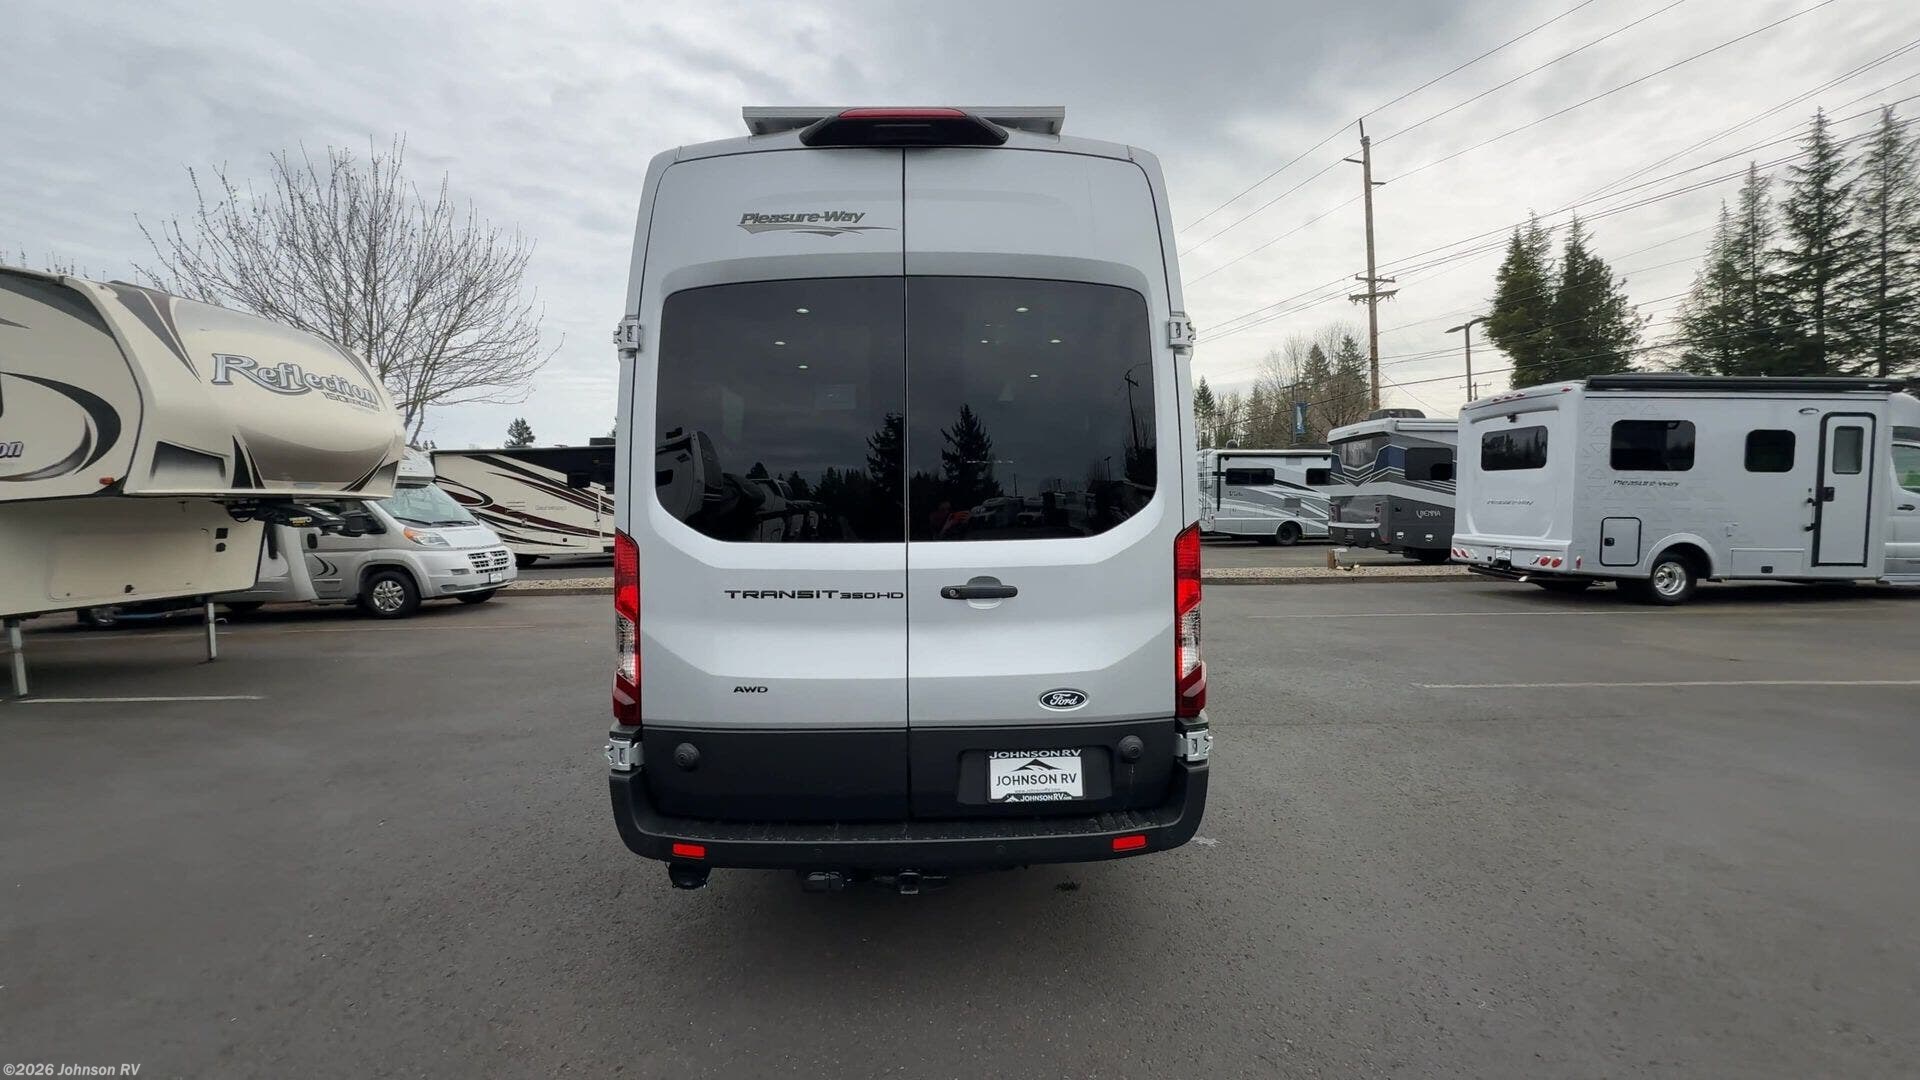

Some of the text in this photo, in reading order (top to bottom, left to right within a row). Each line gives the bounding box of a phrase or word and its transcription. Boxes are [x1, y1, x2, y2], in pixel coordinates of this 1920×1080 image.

[740, 211, 866, 224] Pleasure-Way
[211, 353, 379, 405] Reflection
[724, 590, 839, 599] TRANSIT
[1049, 693, 1078, 705] Ford
[996, 773, 1077, 786] JOHNSON RV
